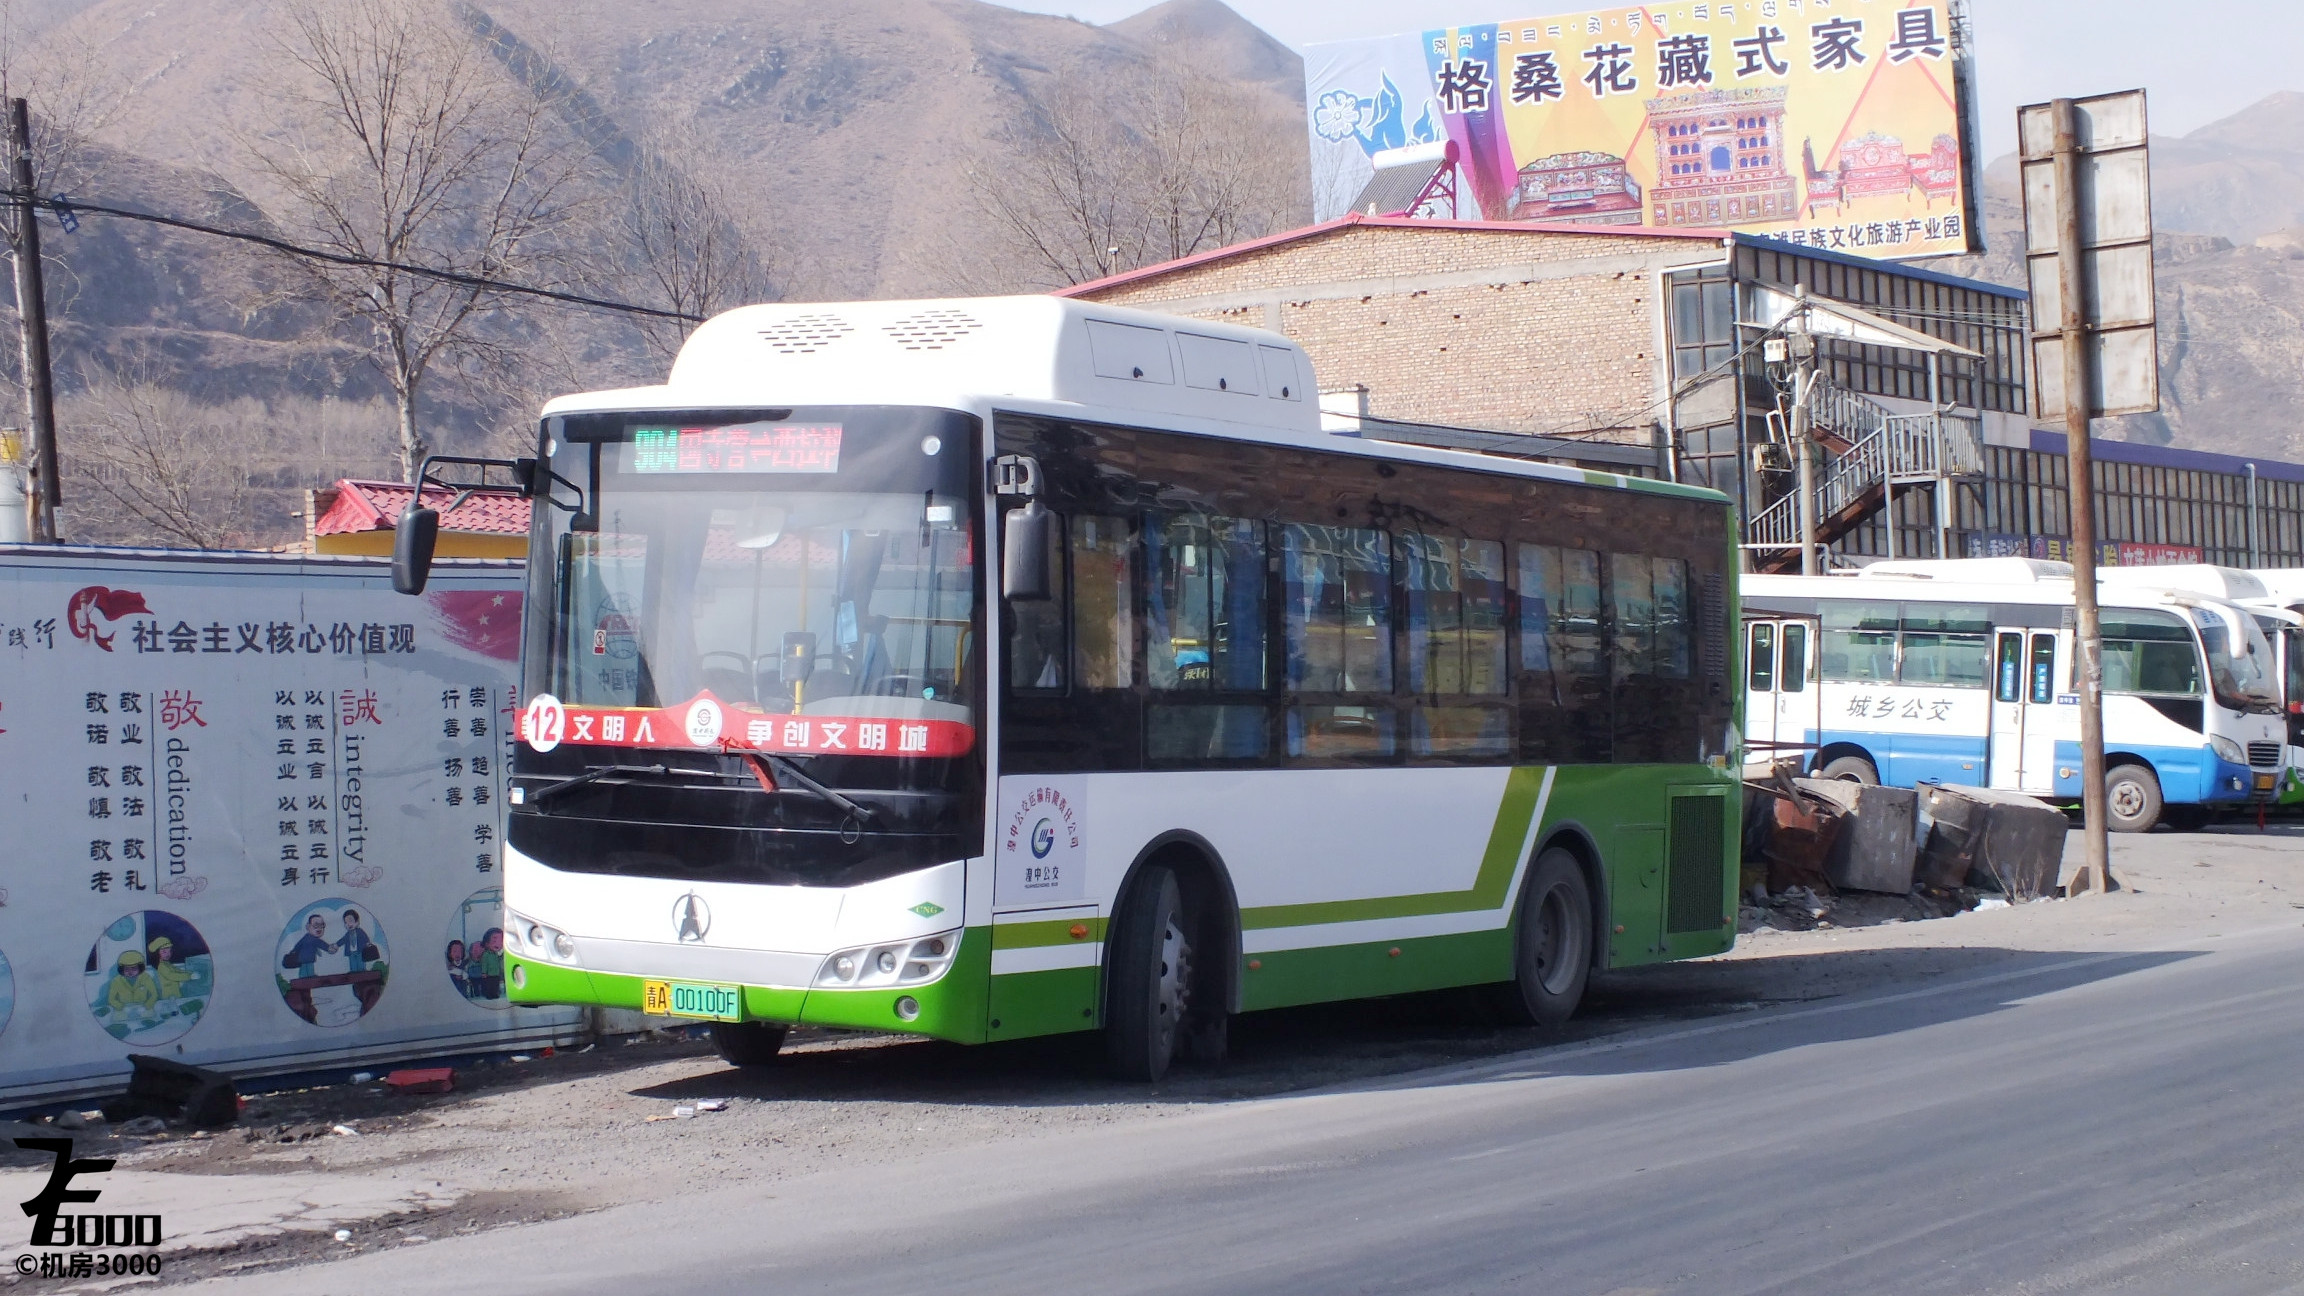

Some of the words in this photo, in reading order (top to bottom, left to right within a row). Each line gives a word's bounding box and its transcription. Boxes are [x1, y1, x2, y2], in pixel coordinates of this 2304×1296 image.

[1437, 8, 1946, 112] 格桑花藏式家具
[1760, 215, 1961, 249] 民族文化旅游产业园
[132, 620, 416, 654] 社会主义核心价值观
[160, 689, 208, 730] 敬
[531, 705, 558, 742] 12
[1846, 695, 1953, 721] 城乡公交
[521, 714, 655, 743] 文明人
[747, 720, 929, 752] 争创文明城
[167, 738, 192, 876] dedication
[342, 734, 368, 863] integrity
